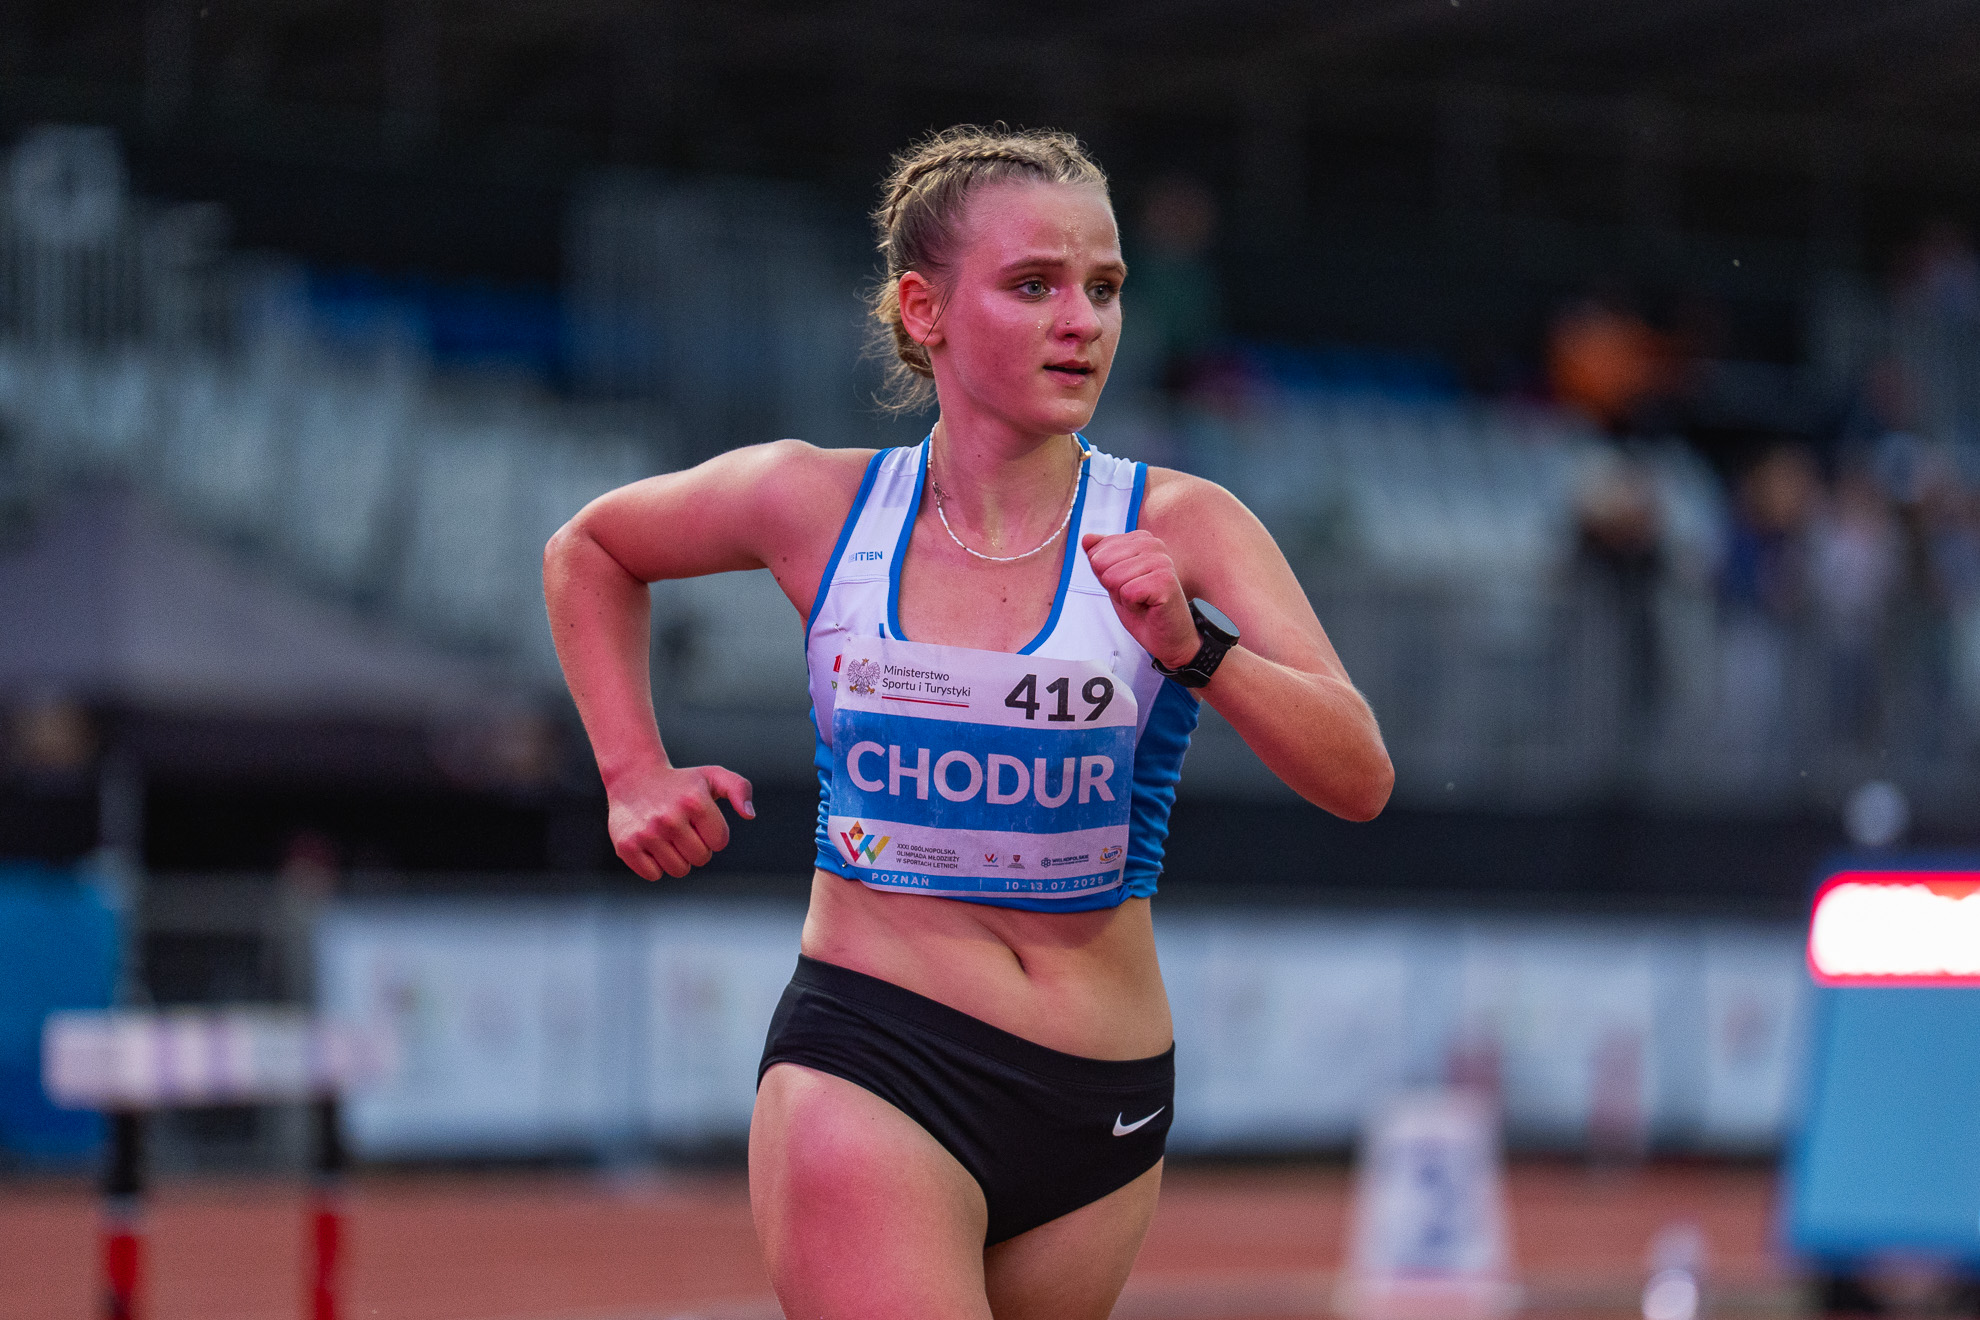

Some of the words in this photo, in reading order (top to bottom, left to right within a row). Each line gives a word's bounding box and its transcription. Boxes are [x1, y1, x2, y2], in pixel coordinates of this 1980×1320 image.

[883, 664, 950, 681] Ministerstwo
[882, 678, 916, 691] Sportu
[918, 682, 922, 691] i
[925, 682, 971, 697] Turystyki
[1004, 673, 1115, 722] 419
[846, 741, 1116, 808] CHODUR
[896, 850, 926, 859] OLIMPIADA
[910, 845, 956, 855] OGÓLNOPOLSKA
[903, 858, 932, 867] SPORTACH
[871, 872, 930, 886] POZNAŃ
